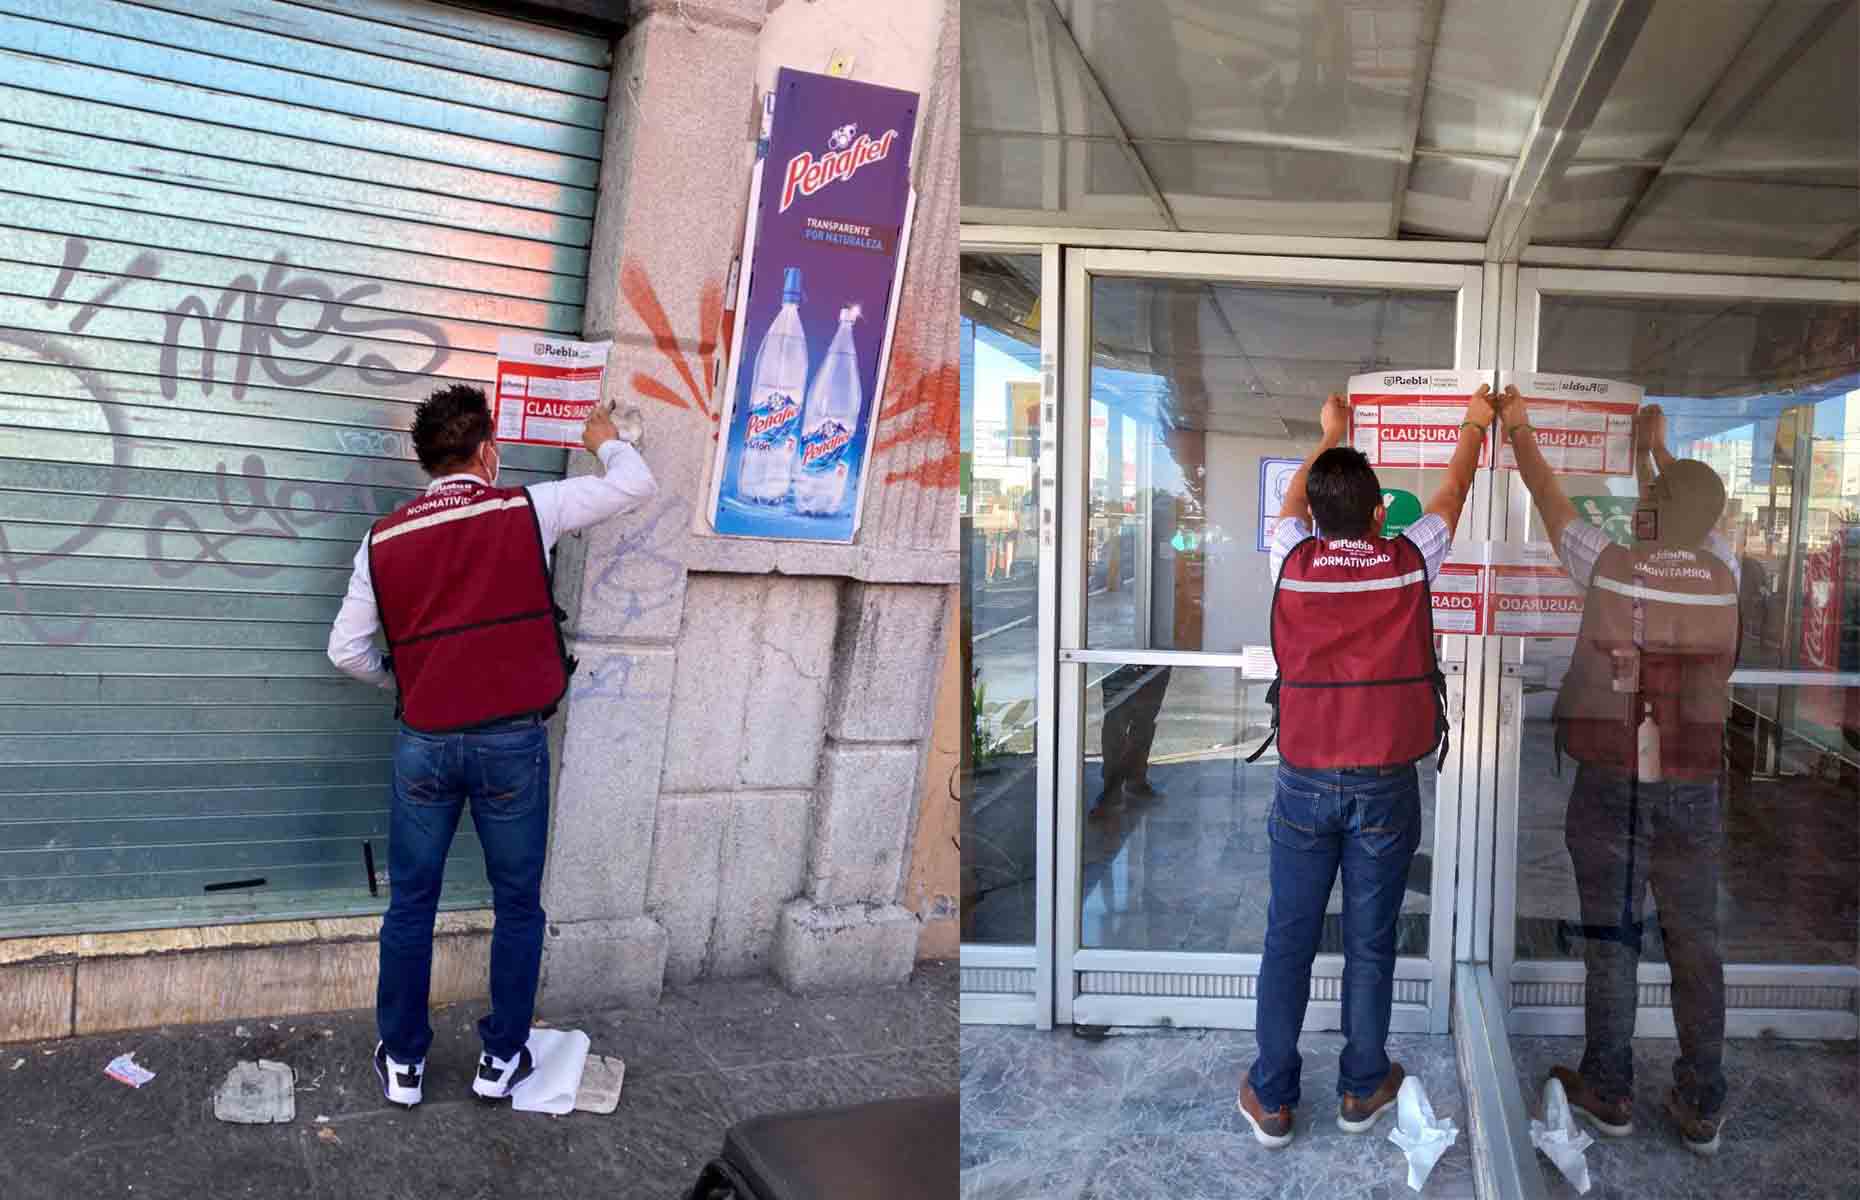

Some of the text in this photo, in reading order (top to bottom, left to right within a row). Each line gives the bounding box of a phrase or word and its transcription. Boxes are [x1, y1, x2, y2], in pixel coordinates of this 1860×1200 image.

[778, 128, 898, 214] Peñafiel
[807, 218, 872, 236] TRANSPARENTE
[805, 229, 885, 250] POR NATURALEZA
[545, 343, 579, 358] Puebla
[1395, 376, 1429, 386] Puebla
[1381, 428, 1462, 441] CLAUSURA
[1312, 554, 1391, 568] NORMATIVIDAD
